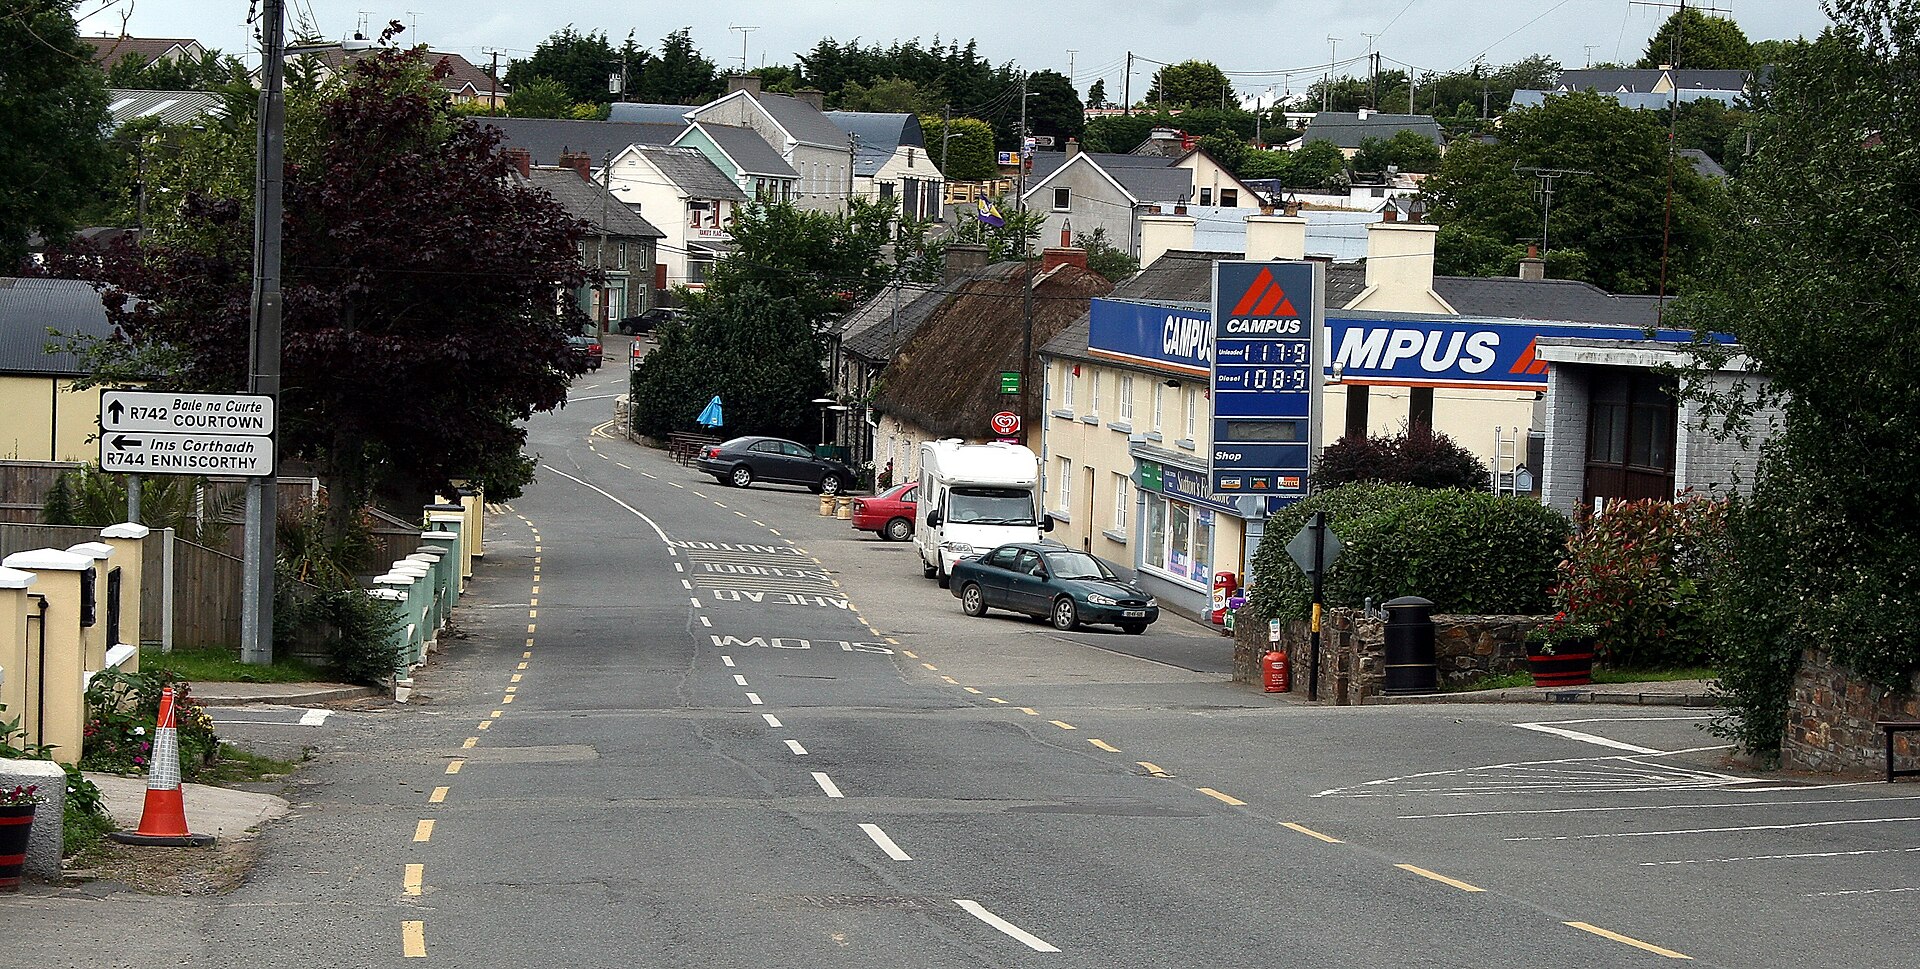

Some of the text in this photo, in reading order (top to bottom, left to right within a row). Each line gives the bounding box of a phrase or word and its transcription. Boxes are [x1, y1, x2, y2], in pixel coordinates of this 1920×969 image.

[1226, 319, 1301, 334] CAMPUS
[1323, 326, 1500, 374] MPUS
[172, 398, 262, 413] Baile na Cúirte
[130, 407, 168, 420] R742
[173, 415, 263, 429] COURTOWN
[150, 438, 177, 450] Inis
[107, 453, 258, 469] R744 ENNISCORTHY
[1215, 451, 1242, 462] Shop
[1177, 471, 1200, 497] Sutton's
[669, 540, 802, 555] CAUTION
[713, 589, 849, 609] AHEAD
[710, 635, 895, 655] SLOW
